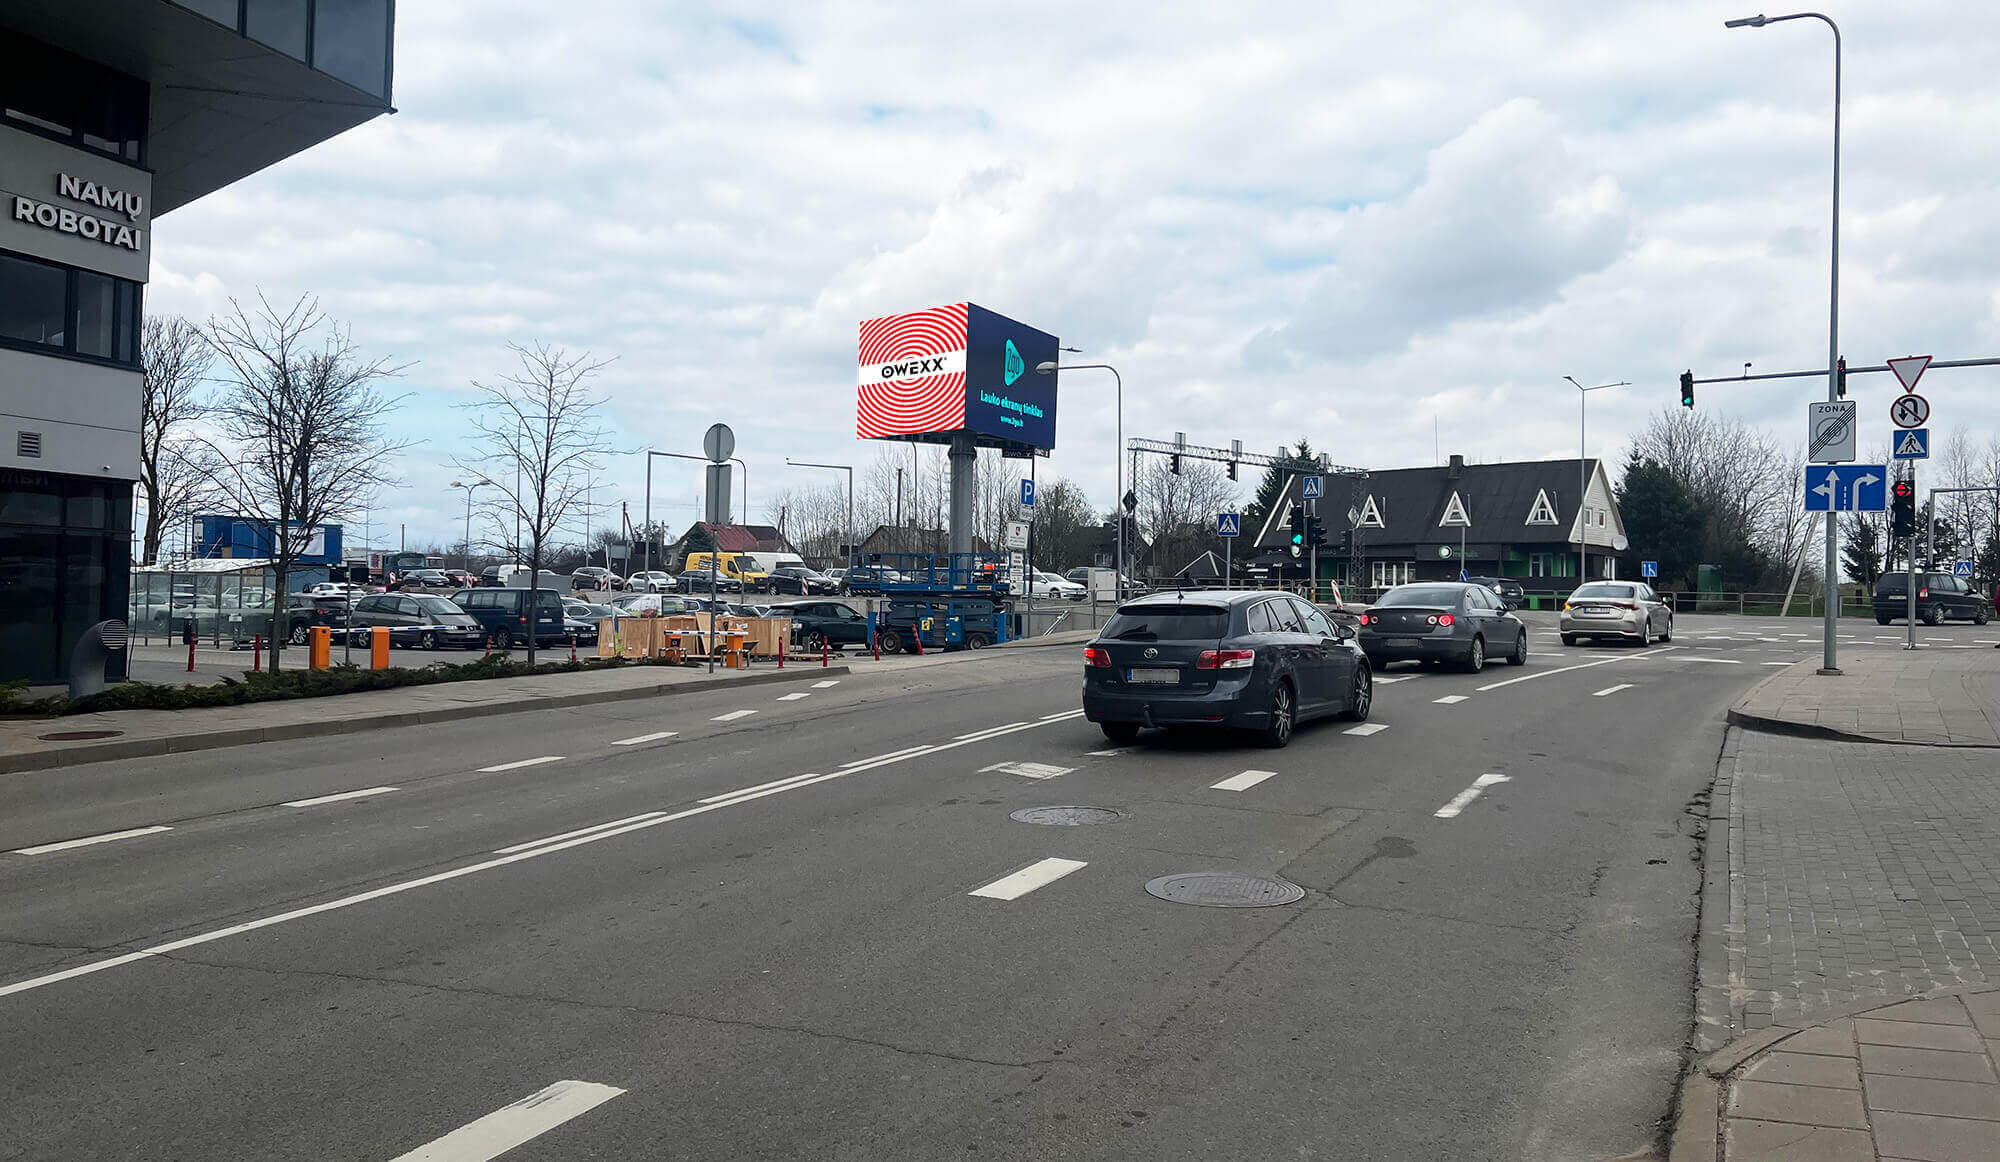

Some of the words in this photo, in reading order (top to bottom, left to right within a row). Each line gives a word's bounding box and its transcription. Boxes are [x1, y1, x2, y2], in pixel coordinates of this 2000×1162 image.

[58, 173, 142, 221] NAMŲ
[15, 196, 141, 250] ROBOTAI
[881, 356, 944, 379] OWEXX
[980, 389, 1001, 406] Lauko
[1818, 405, 1846, 413] ZONA
[1024, 482, 1033, 502] P
